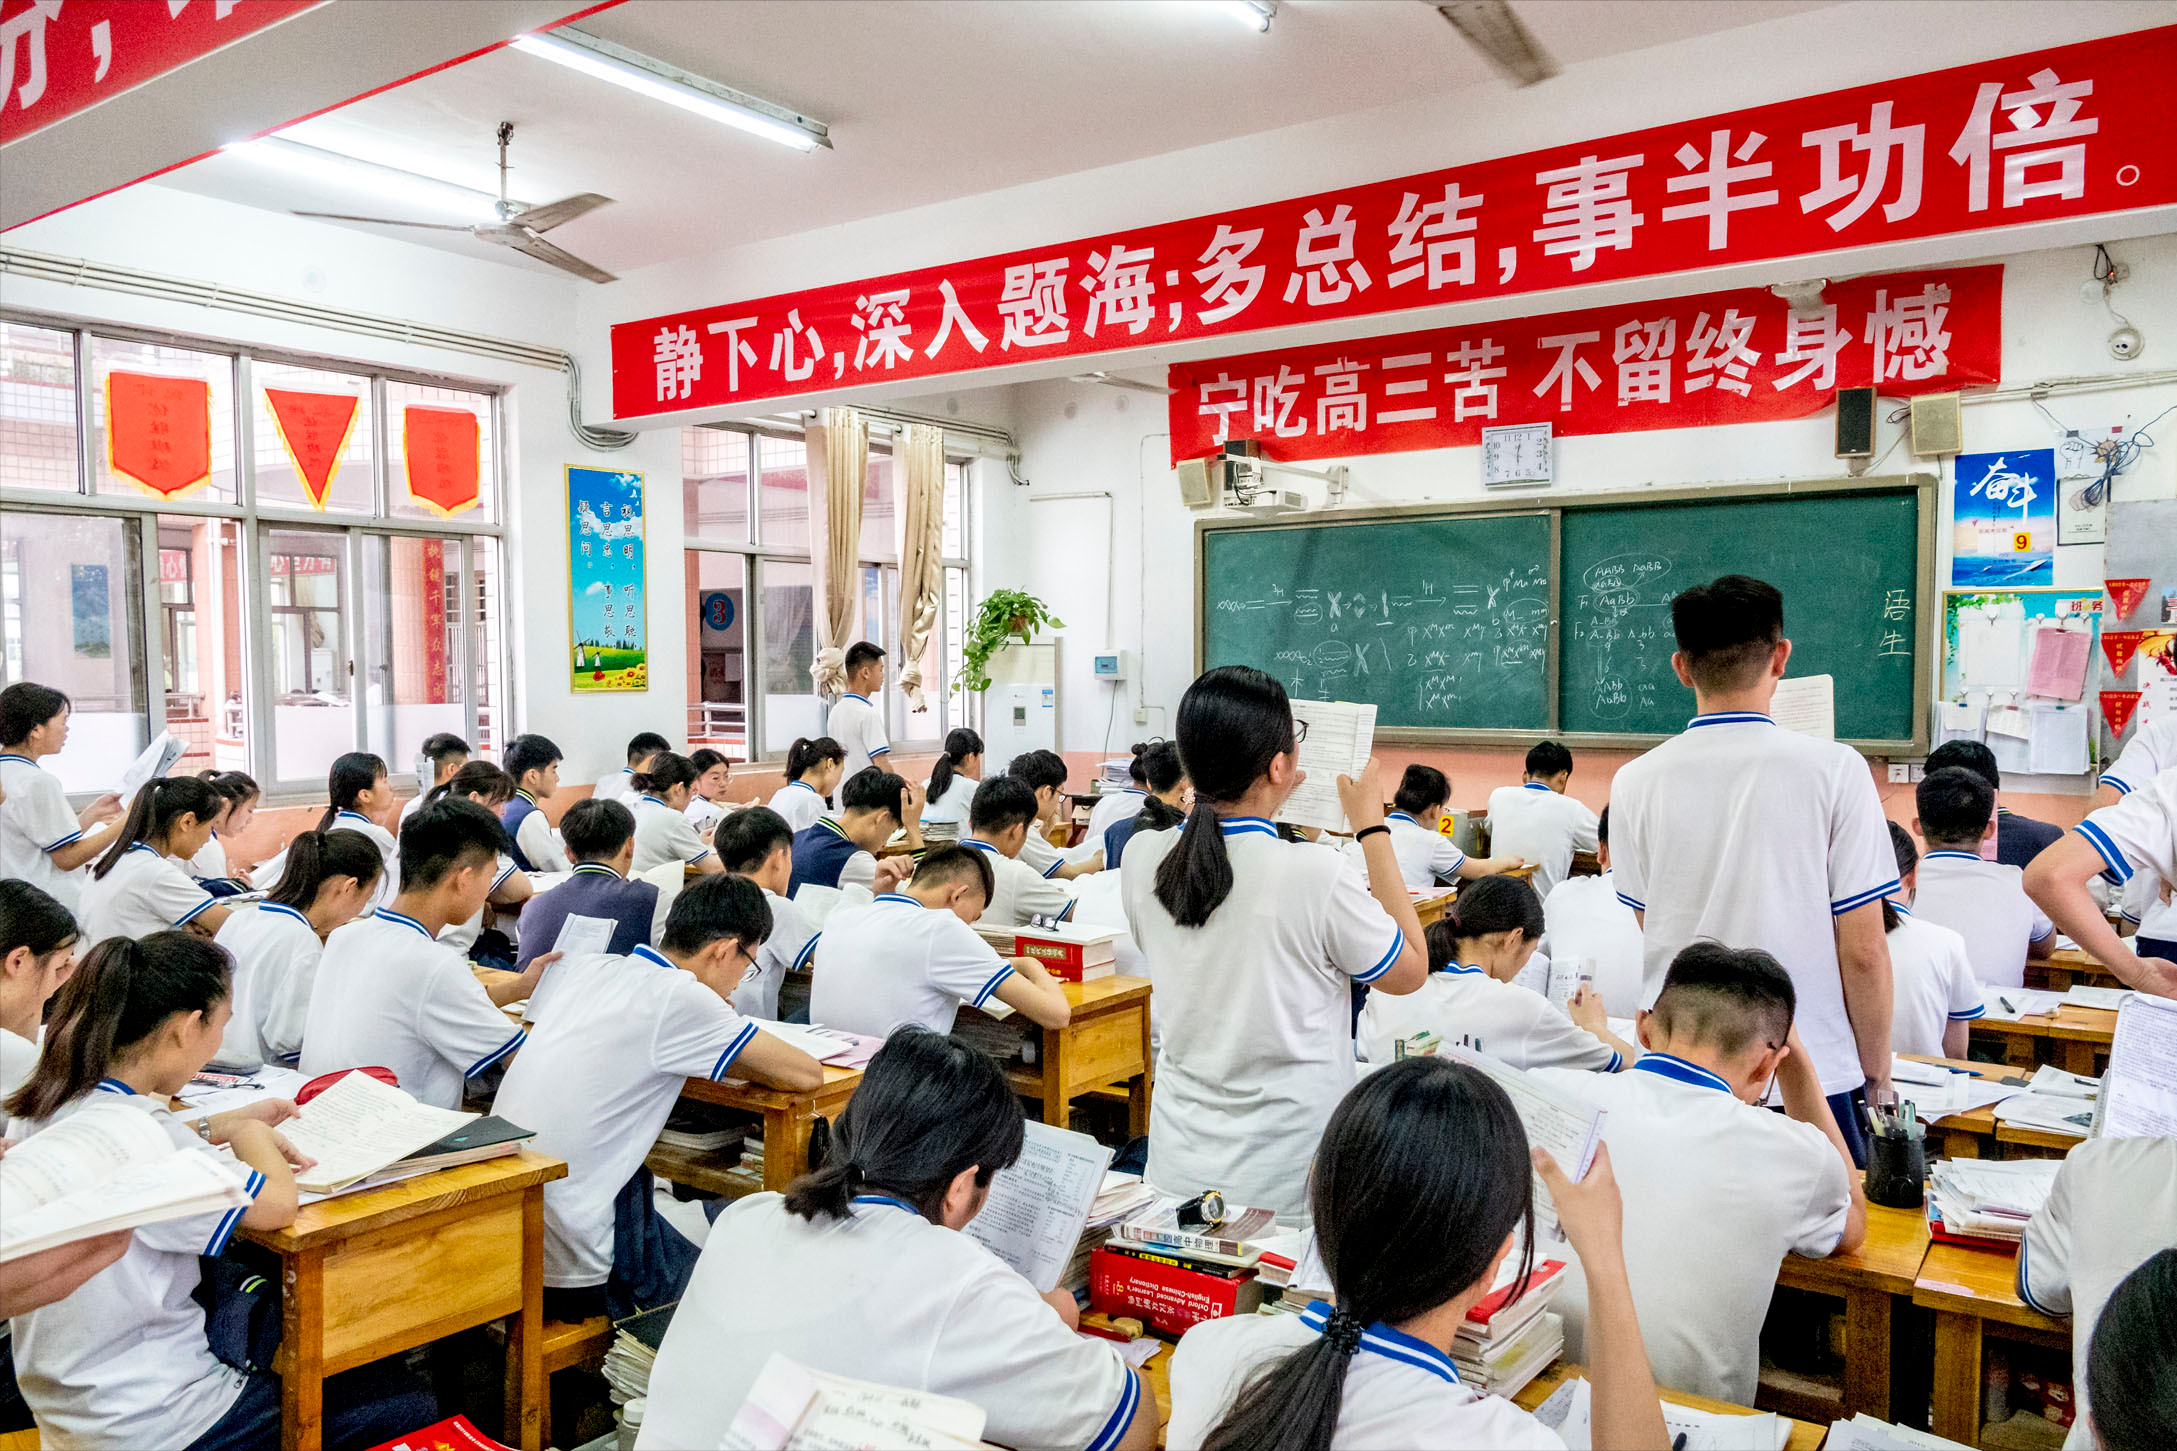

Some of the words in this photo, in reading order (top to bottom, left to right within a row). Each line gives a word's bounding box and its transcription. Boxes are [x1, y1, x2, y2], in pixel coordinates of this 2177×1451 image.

[1198, 338, 1508, 447] 宁吃高三苦
[1533, 282, 1953, 411] 不留终身憾
[2016, 534, 2027, 549] 9
[713, 599, 726, 624] 3
[1442, 816, 1452, 835] 2
[1127, 1284, 1154, 1298] Learner's
[1129, 1276, 1159, 1291] Dictionary
[1156, 1292, 1186, 1306] Advanced
[1162, 1285, 1210, 1304] English-Chinese
[1188, 1300, 1209, 1312] Oxford
